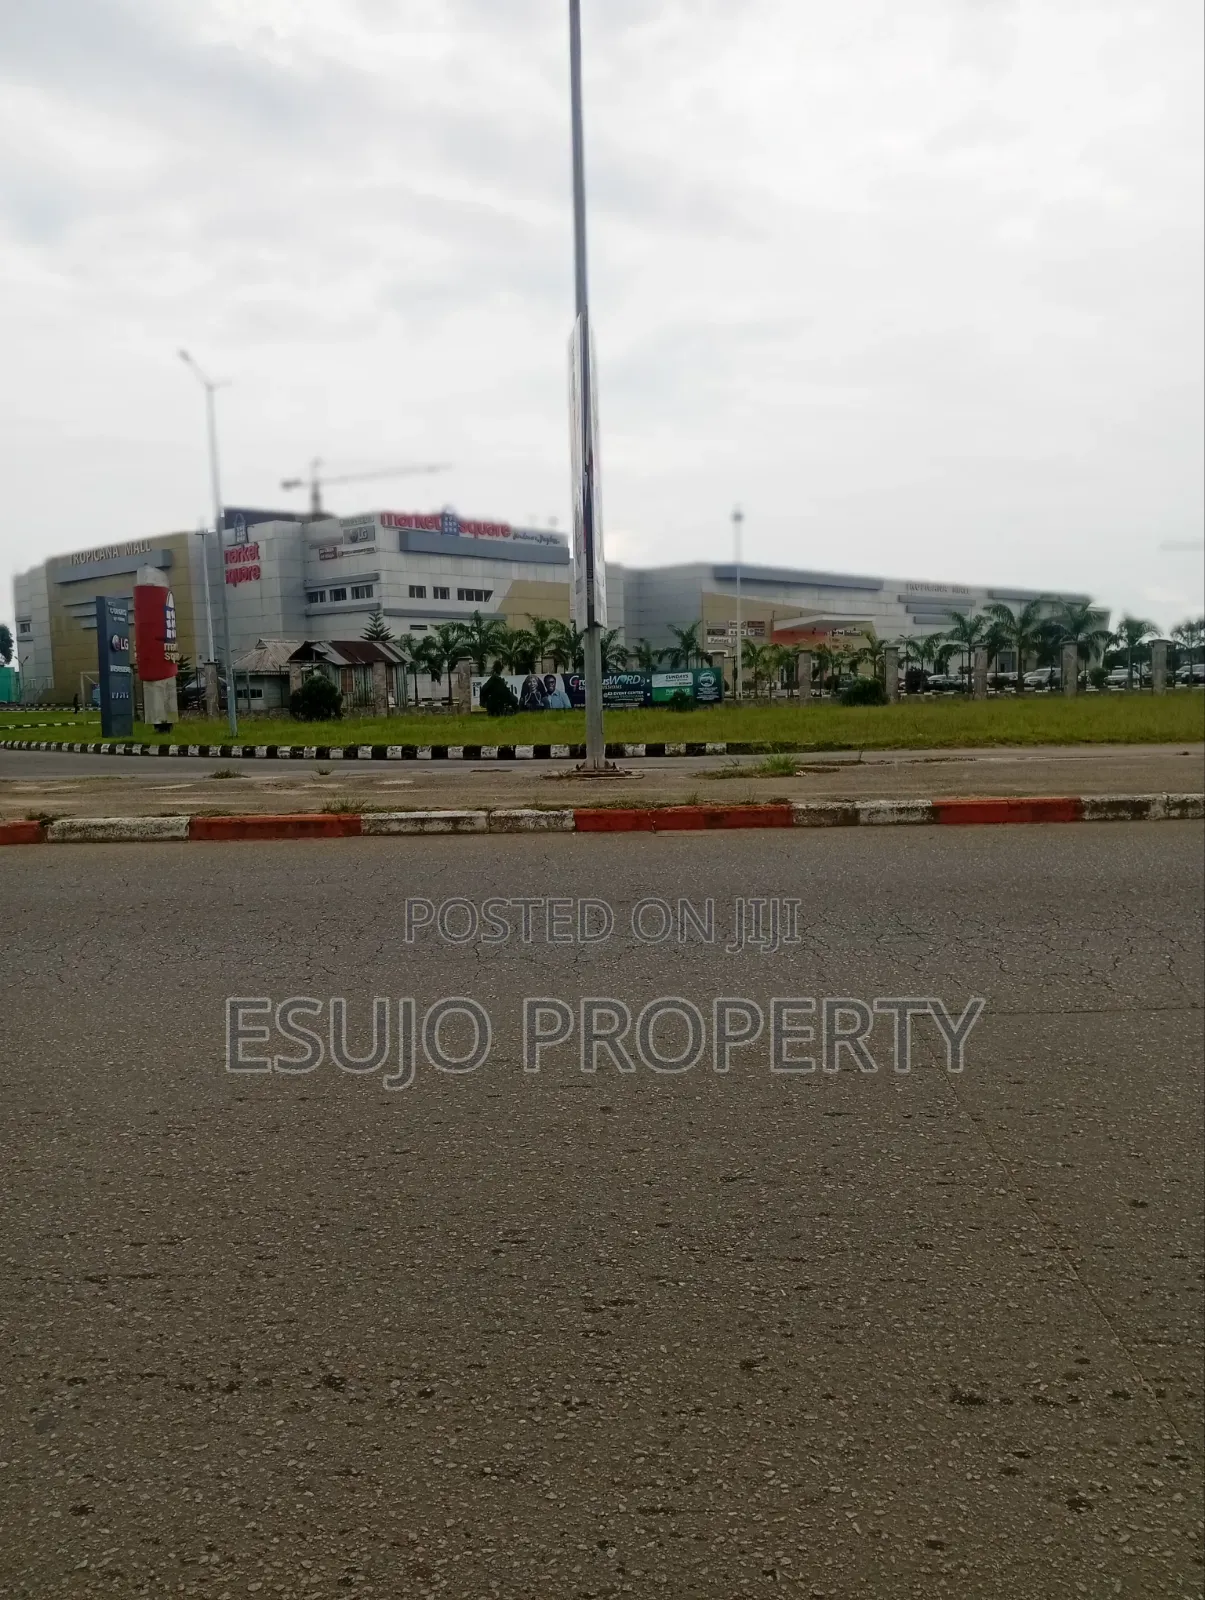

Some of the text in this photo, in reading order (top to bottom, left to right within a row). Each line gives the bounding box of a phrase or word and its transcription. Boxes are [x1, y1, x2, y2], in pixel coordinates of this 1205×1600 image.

[358, 528, 368, 540] LG
[380, 512, 442, 531] market
[458, 519, 513, 540] square
[69, 540, 152, 566] TROPICANA MALL
[120, 637, 129, 650] LG
